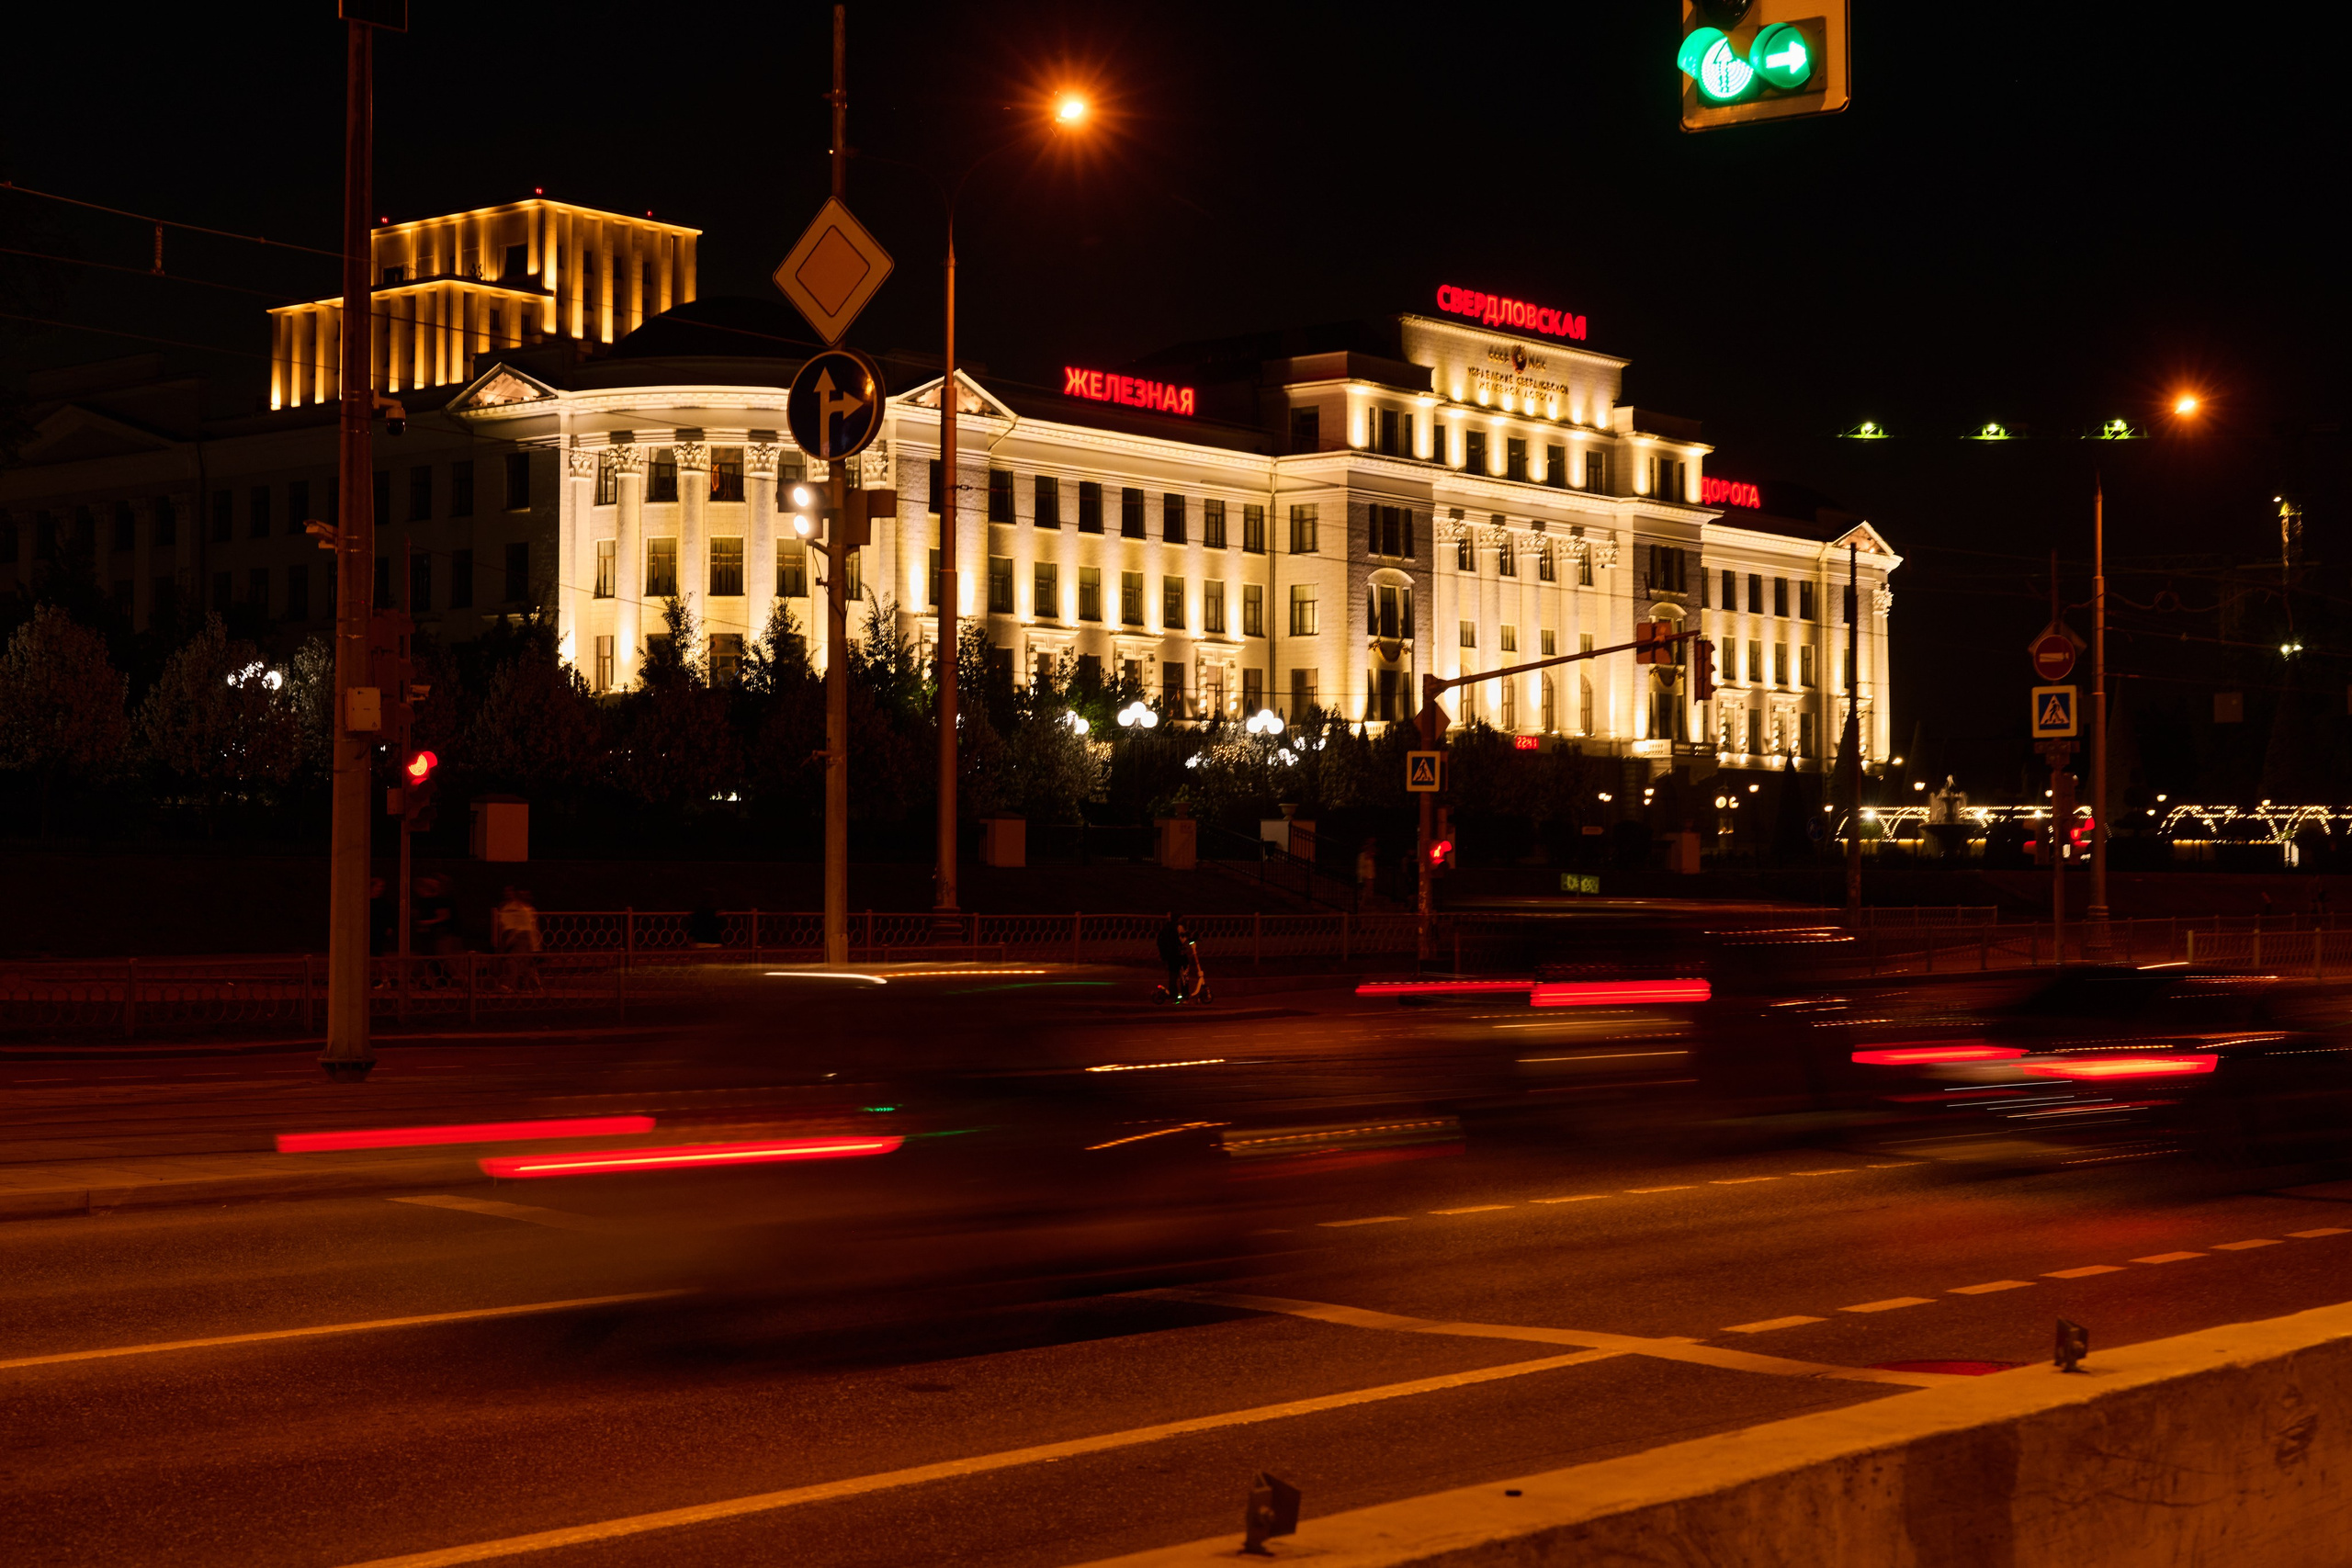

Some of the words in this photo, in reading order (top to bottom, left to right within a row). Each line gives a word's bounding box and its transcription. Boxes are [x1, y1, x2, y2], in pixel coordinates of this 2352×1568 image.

[1437, 284, 1587, 341] СВЕРДЛОВСКАЯ
[1064, 367, 1194, 415] ЖЕЛЕЗНАЯ
[1702, 476, 1761, 509] ДОРОГА
